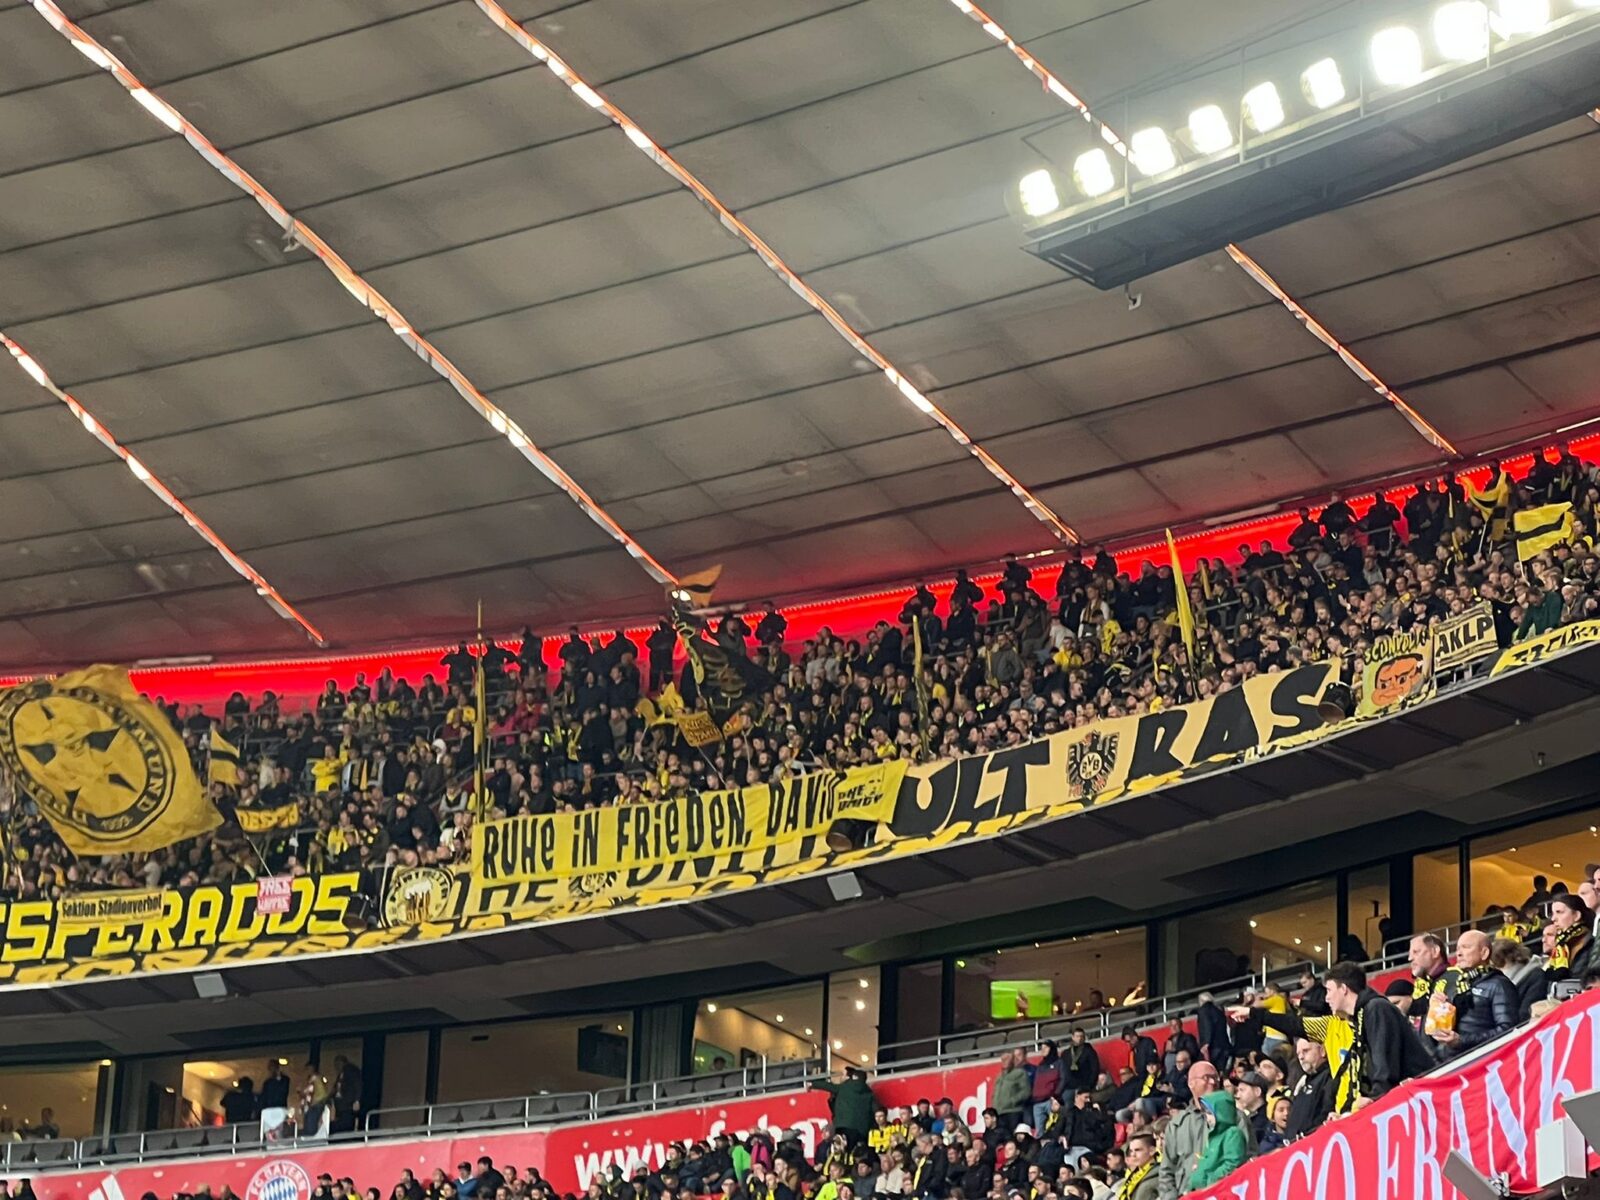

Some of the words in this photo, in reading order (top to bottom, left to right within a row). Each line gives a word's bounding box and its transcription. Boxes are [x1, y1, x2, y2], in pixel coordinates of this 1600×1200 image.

[1436, 614, 1494, 659] AKLP
[1082, 754, 1100, 774] BVB
[0, 872, 360, 962] SPERADOS
